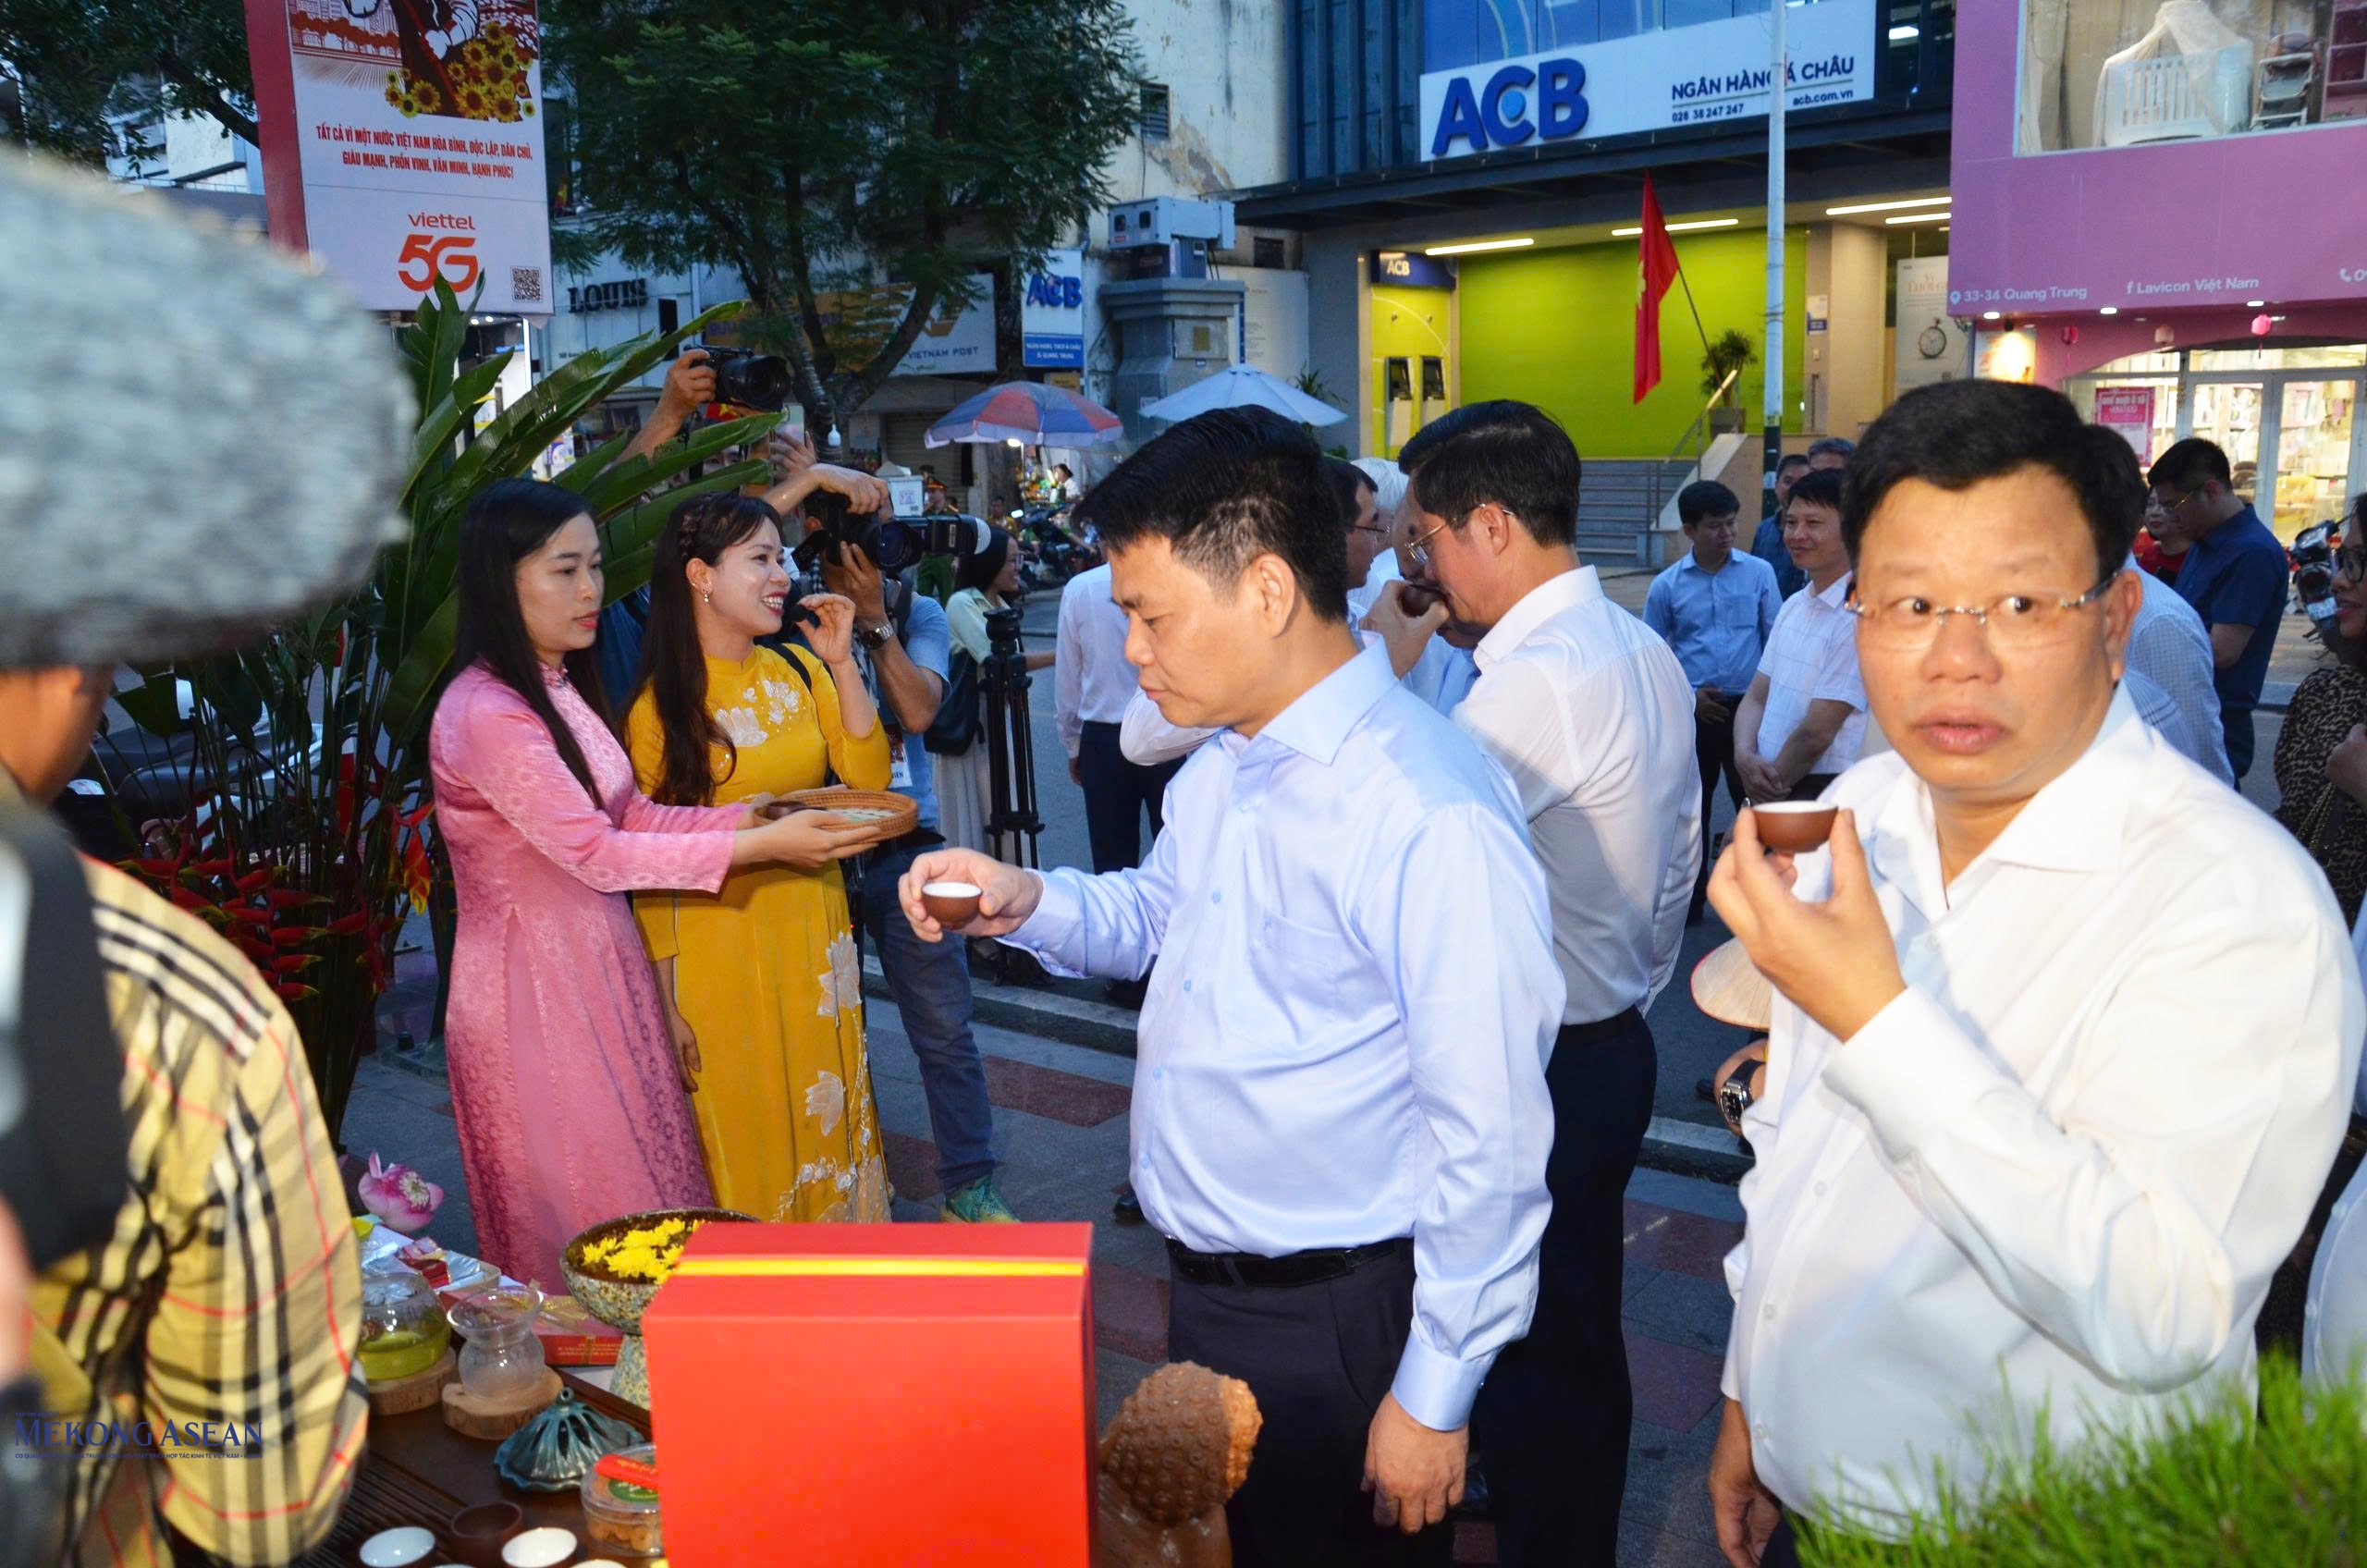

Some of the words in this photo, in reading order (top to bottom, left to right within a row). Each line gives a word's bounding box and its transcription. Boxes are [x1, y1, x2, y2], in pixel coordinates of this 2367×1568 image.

[1672, 77, 1721, 101] NGÂN
[1726, 69, 1771, 93] HÀN
[1801, 55, 1855, 80] CHÂU
[1431, 58, 1589, 156] ACB
[1793, 90, 1854, 106] acb.com.vn
[1672, 110, 1689, 123] 028
[1693, 108, 1704, 120] 38
[1706, 105, 1723, 118] 247
[1726, 104, 1745, 116] 247
[354, 128, 372, 146] MỘT
[395, 131, 411, 150] VIỆT
[413, 136, 431, 150] NAM
[408, 212, 475, 230] viettel
[399, 234, 478, 292] 5G
[1386, 259, 1411, 276] ACB
[567, 277, 649, 313] LOUIS
[1026, 274, 1083, 308] ACB
[1964, 289, 2000, 302] 33-34
[2004, 288, 2046, 301] Quang
[2049, 286, 2088, 300] Trung
[2137, 280, 2190, 295] Lavicon
[2195, 278, 2221, 293] Việt
[2226, 277, 2259, 289] Nam
[952, 347, 978, 356] POST
